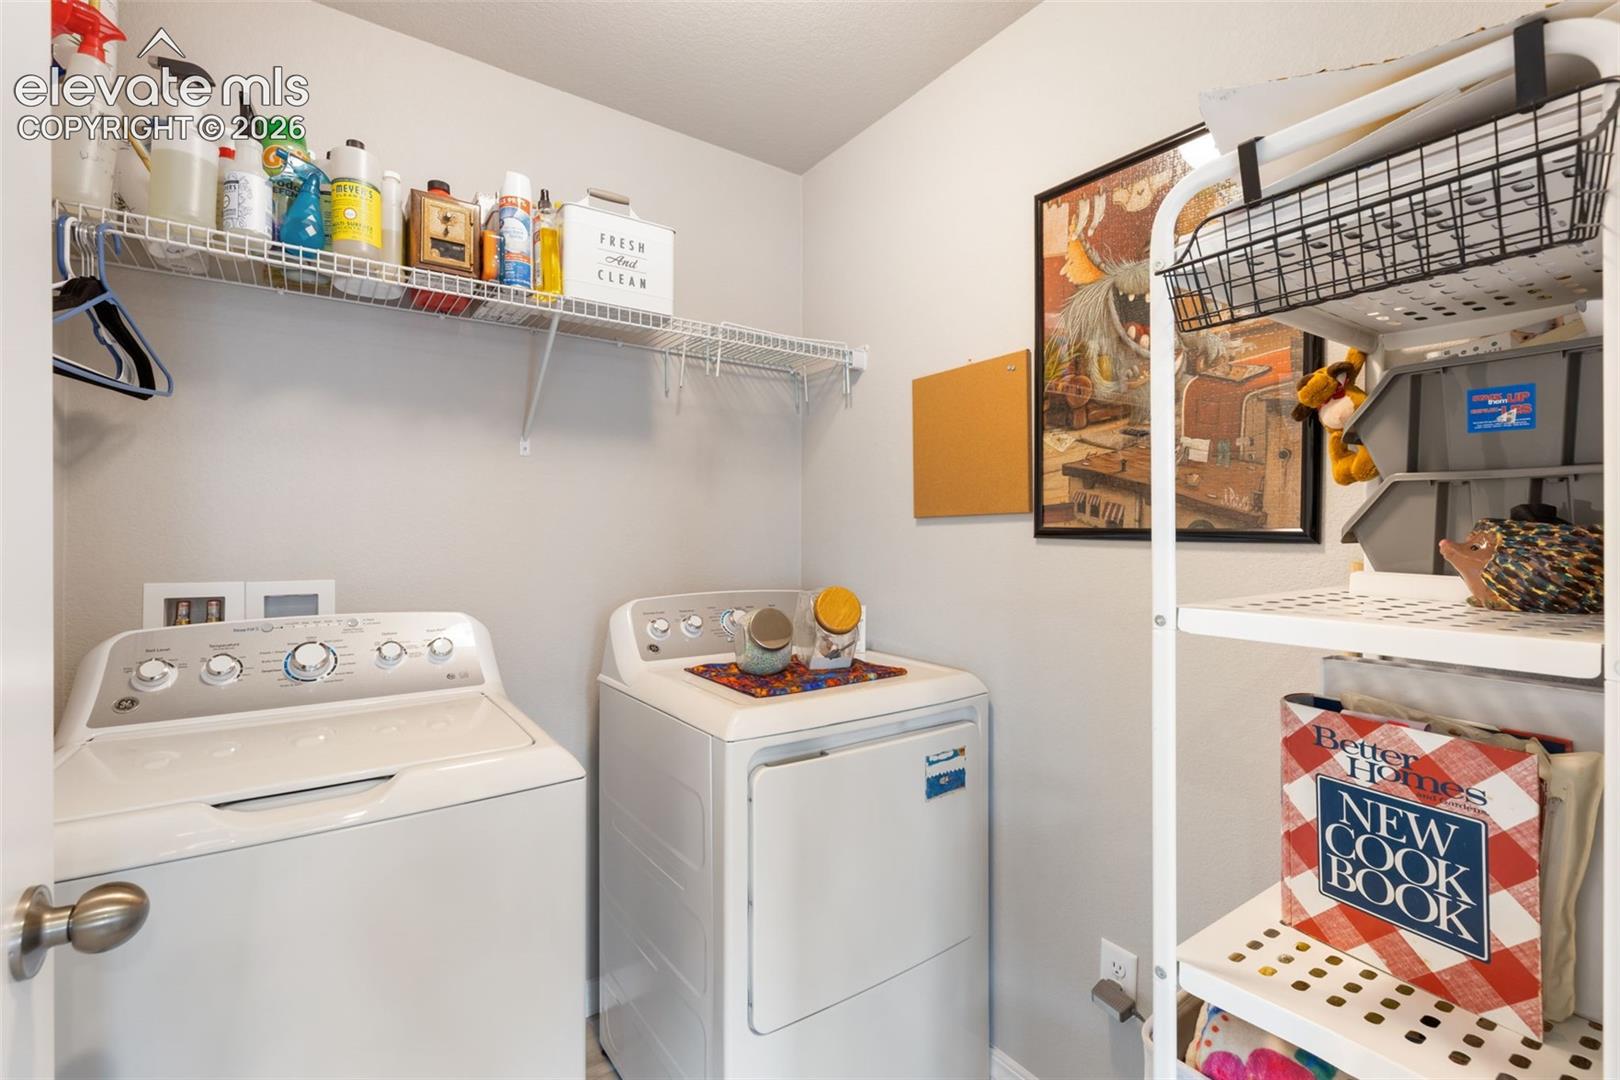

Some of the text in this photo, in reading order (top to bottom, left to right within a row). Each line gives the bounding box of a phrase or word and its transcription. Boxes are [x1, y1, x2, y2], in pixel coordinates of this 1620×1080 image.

[600, 232, 645, 253] FRESH
[605, 255, 638, 269] And
[598, 269, 646, 289] CLEAN
[1312, 725, 1420, 770] Better
[1347, 756, 1488, 806] Homes
[1338, 790, 1459, 857] NEW
[1325, 823, 1476, 905] COOK
[1327, 853, 1478, 944] BOOK
